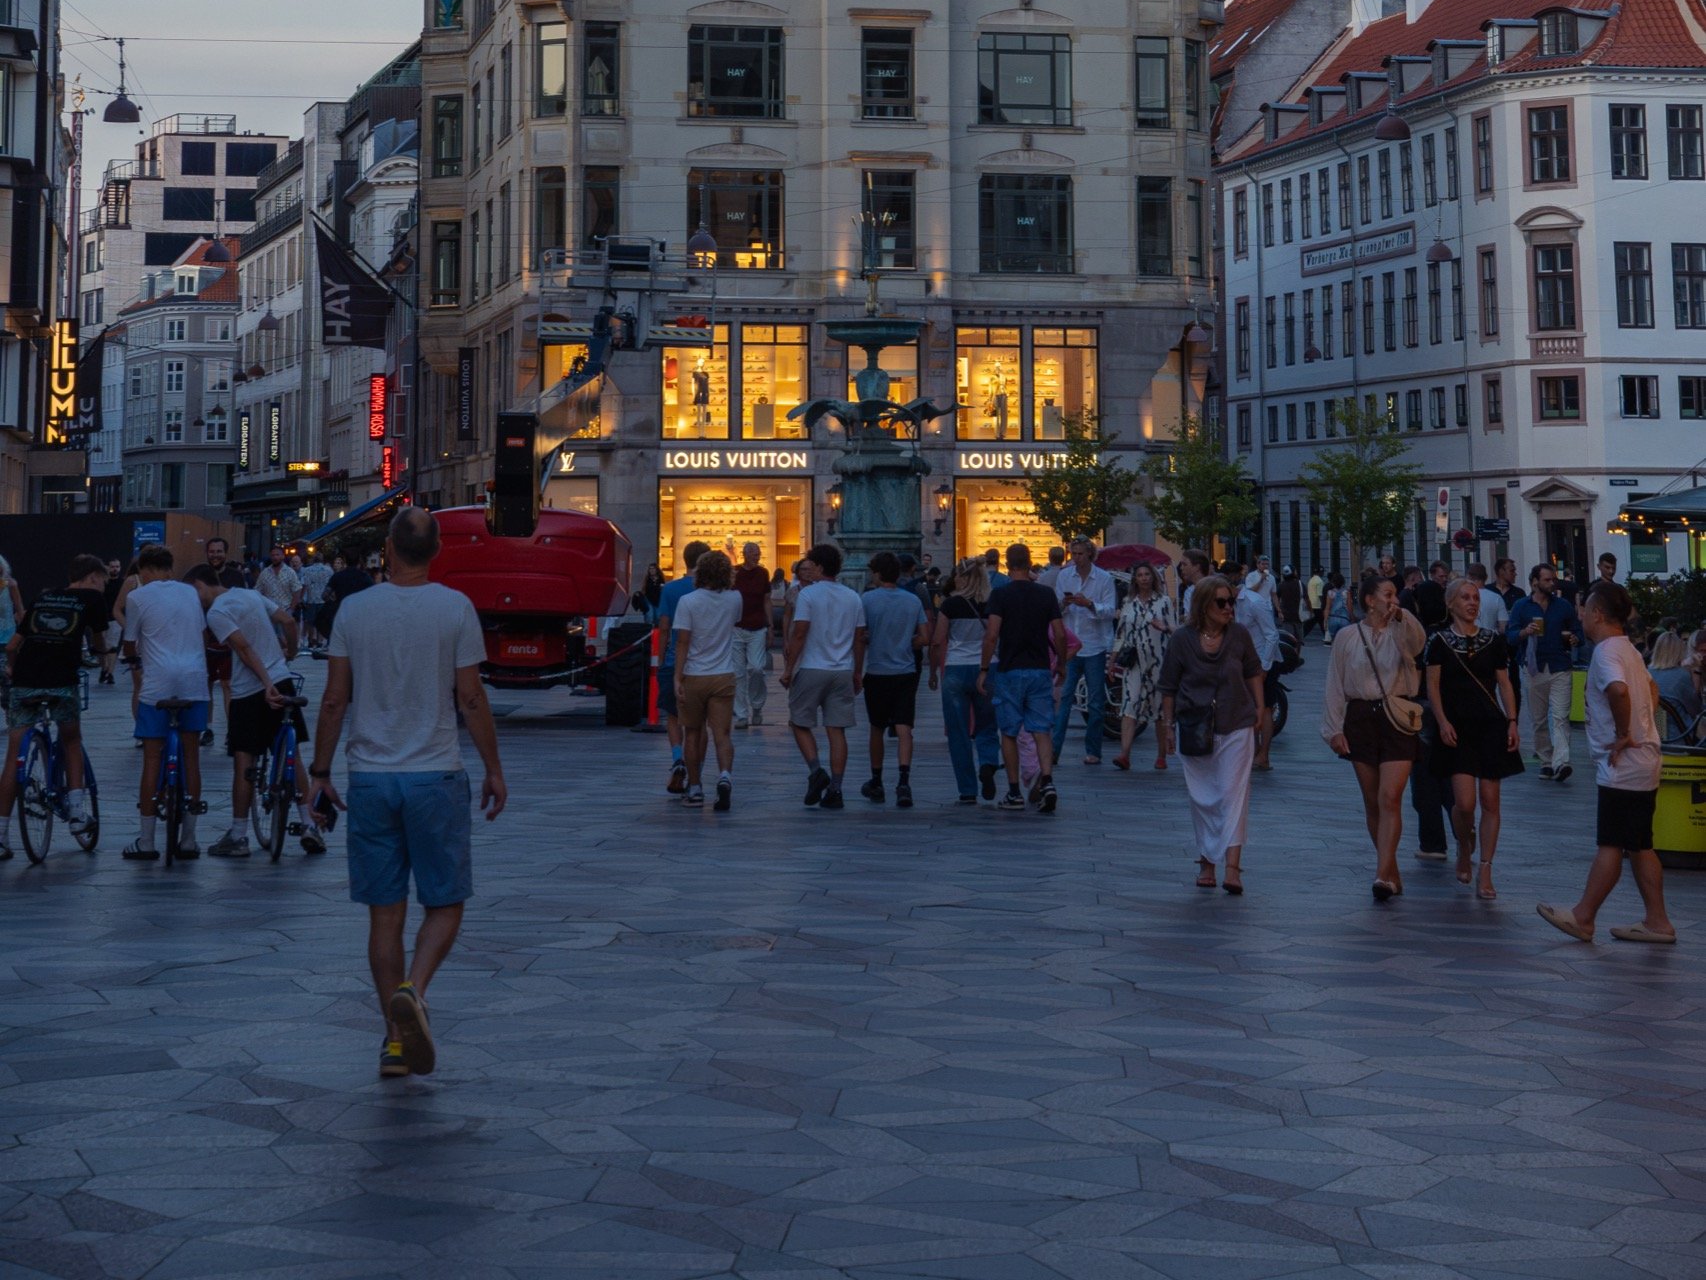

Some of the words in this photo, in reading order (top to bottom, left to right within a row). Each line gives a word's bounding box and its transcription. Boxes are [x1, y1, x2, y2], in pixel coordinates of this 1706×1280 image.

[727, 68, 746, 77] HAY
[878, 69, 896, 78] HAY
[1016, 75, 1033, 84] HAY
[727, 212, 745, 221] HAY
[1017, 216, 1035, 225] HAY
[323, 275, 352, 342] HAY
[50, 321, 77, 418] ILLUM
[461, 360, 470, 387] LOUIS
[371, 377, 385, 411] MAMMA
[461, 389, 470, 430] VUITTON
[271, 407, 280, 456] ELGIGANTEN
[370, 414, 385, 437] ROSA
[240, 416, 249, 463] ELGIGANTEN
[383, 447, 392, 487] PIZZA
[665, 452, 720, 469] LOUIS
[726, 452, 807, 469] VUITTON
[960, 452, 1013, 469] LOUIS
[507, 645, 538, 654] renta
